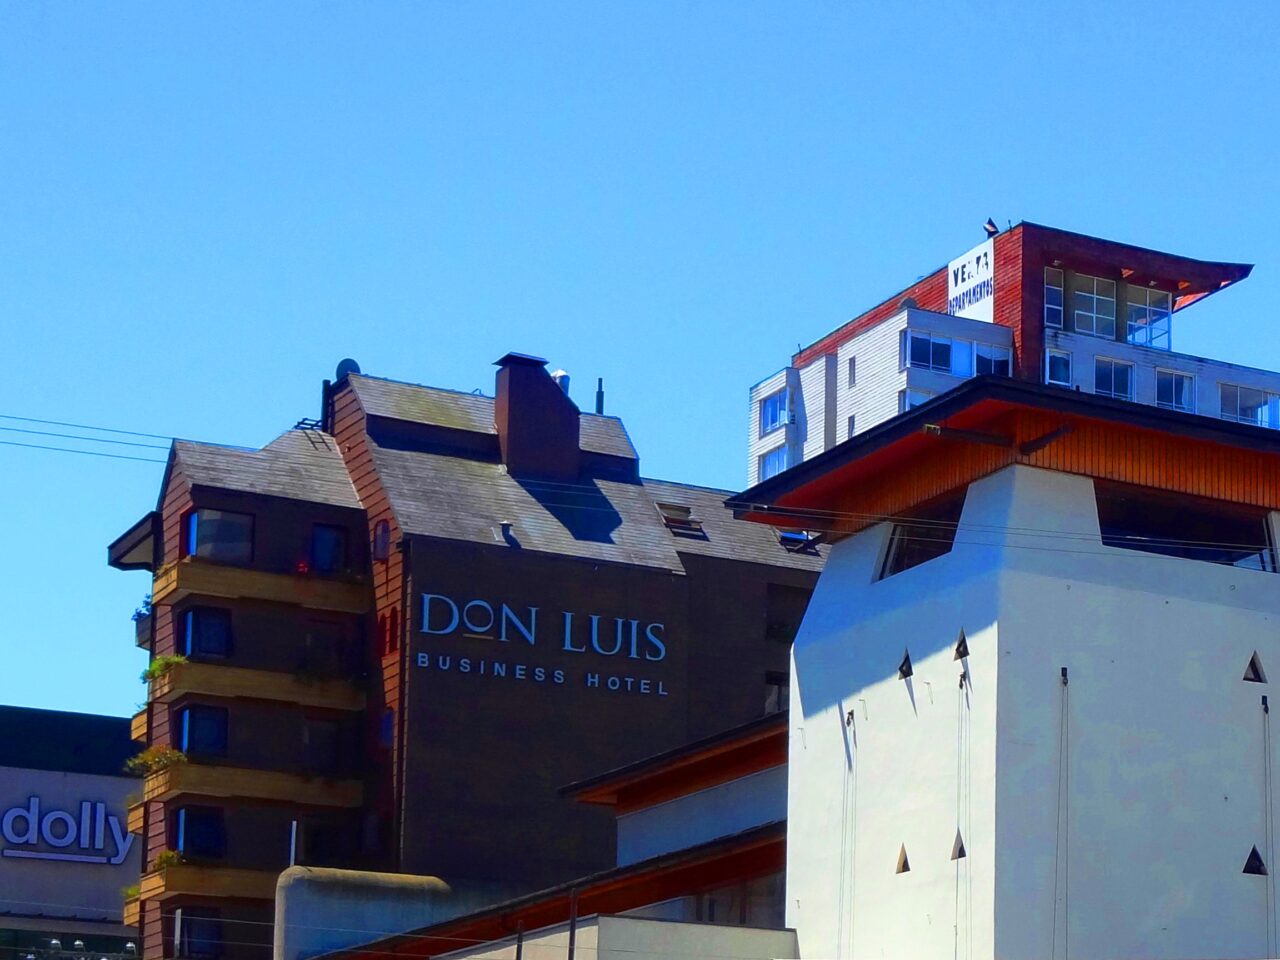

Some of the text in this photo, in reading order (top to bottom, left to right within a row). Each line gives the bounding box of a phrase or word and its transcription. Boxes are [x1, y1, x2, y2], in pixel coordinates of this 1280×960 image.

[420, 592, 667, 661] DON LUIS
[417, 652, 669, 696] BUSINESS HOTEL
[2, 797, 135, 865] dolly
